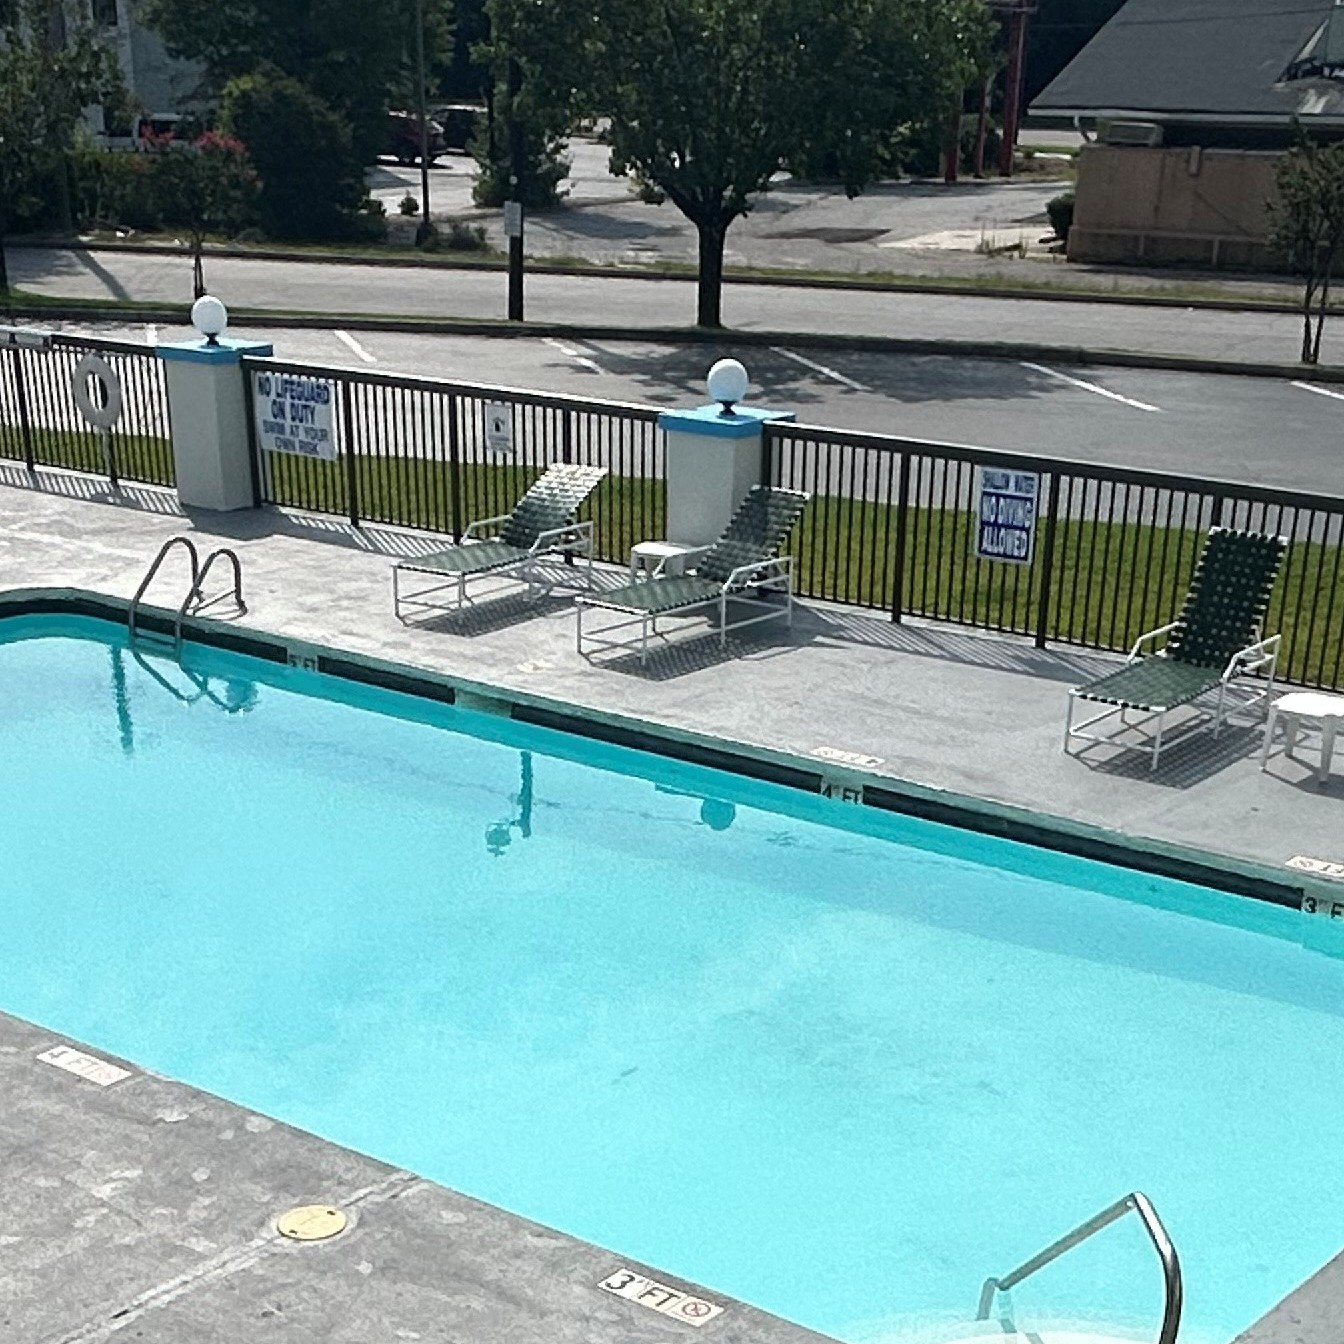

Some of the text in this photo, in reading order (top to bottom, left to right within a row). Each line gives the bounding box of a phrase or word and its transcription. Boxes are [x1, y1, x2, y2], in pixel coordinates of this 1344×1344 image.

[258, 376, 330, 405] NO LIFEGUARD
[271, 399, 315, 425] ON DUTY
[275, 437, 319, 455] OWN RISK
[290, 425, 299, 438] AT
[304, 426, 328, 442] YOUR
[982, 495, 1033, 528] NO DIVING
[981, 526, 1028, 557] ALLOWED
[1304, 896, 1317, 914] 3
[606, 1273, 682, 1308] 3 FT
